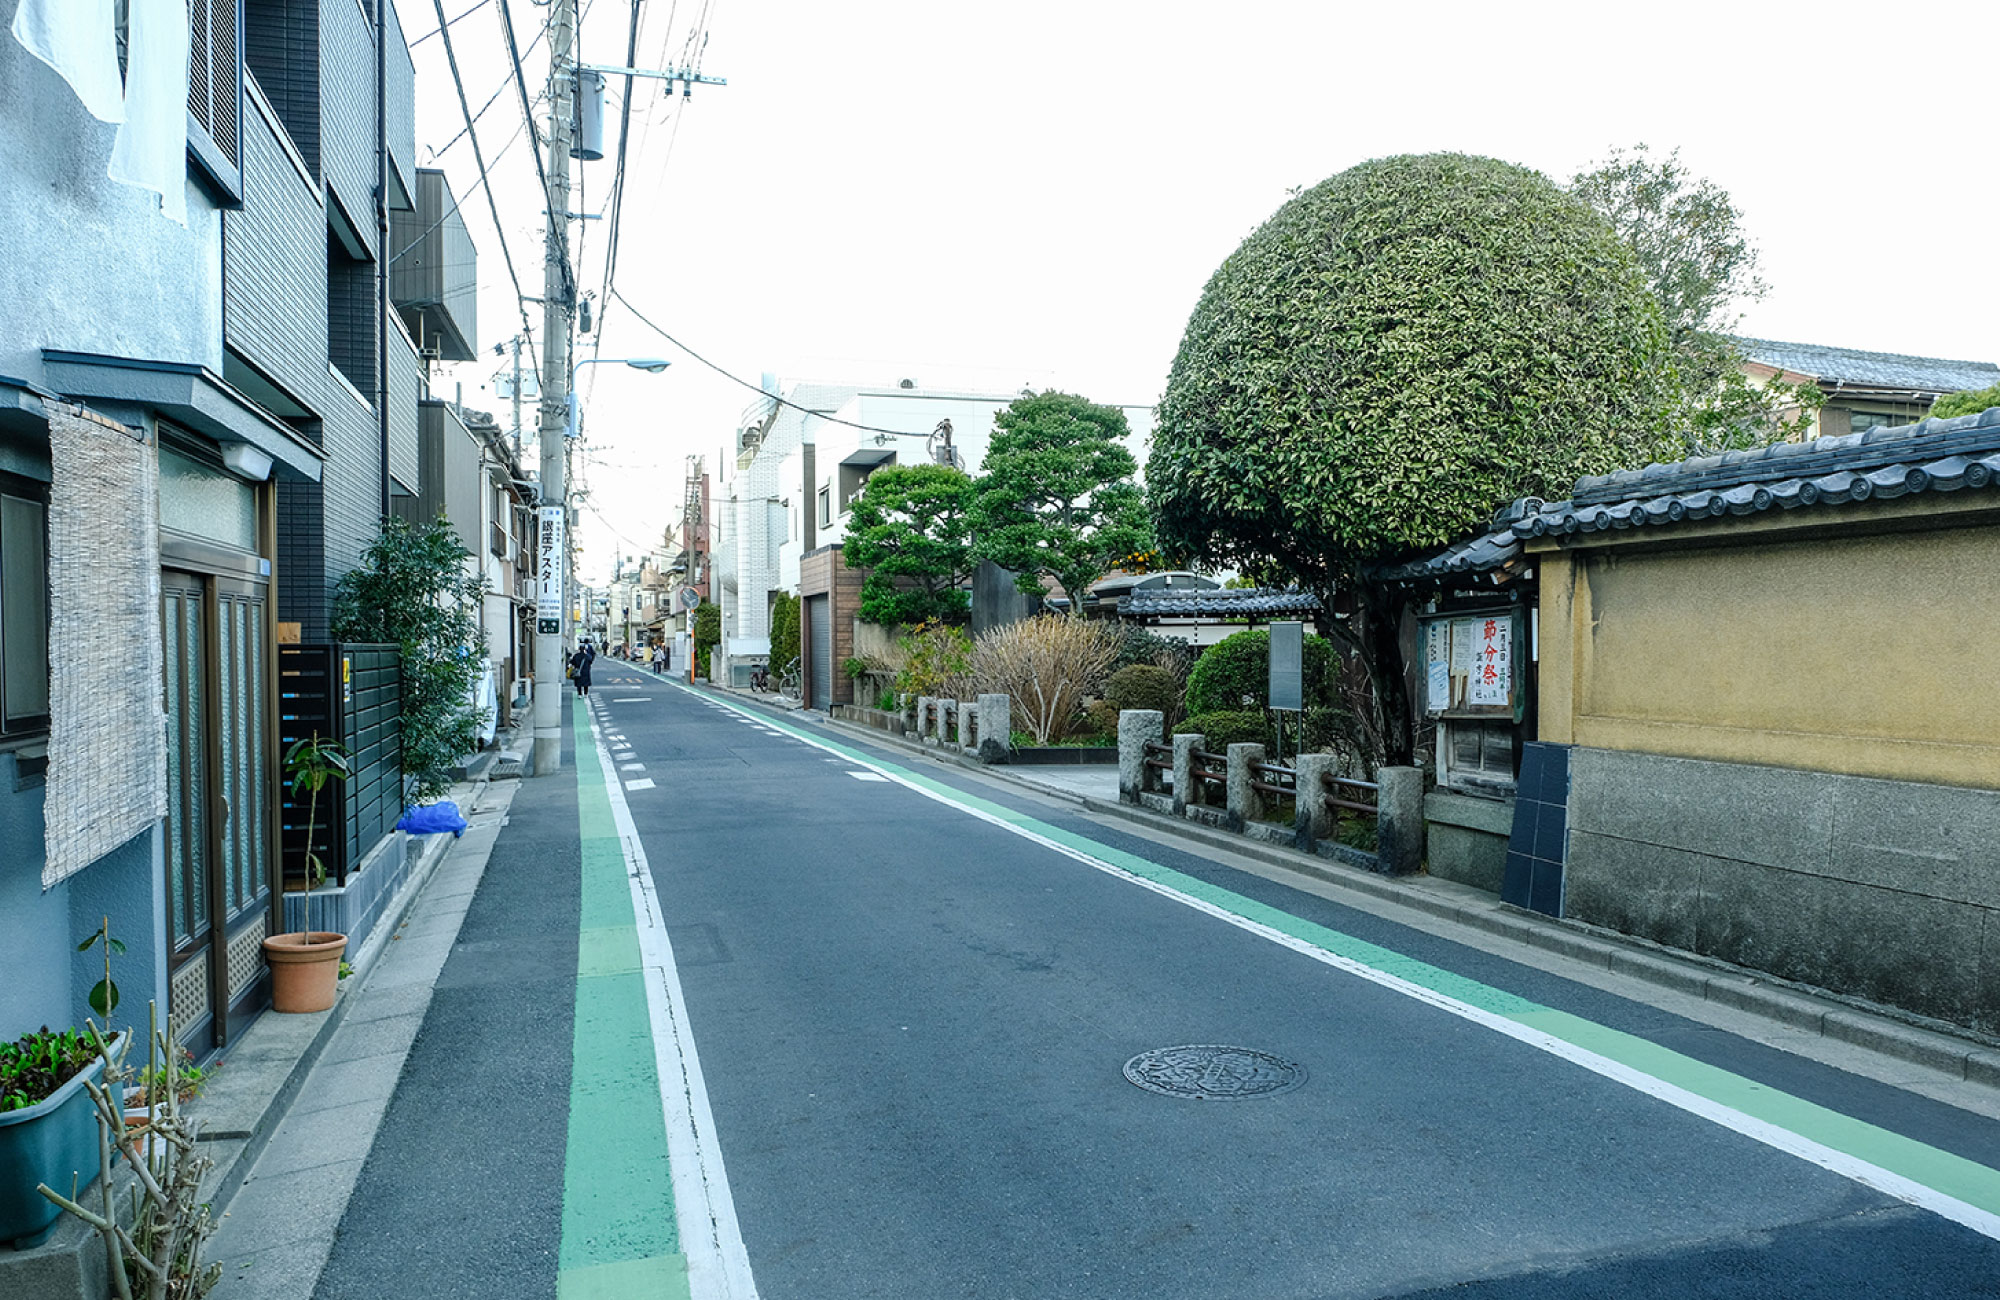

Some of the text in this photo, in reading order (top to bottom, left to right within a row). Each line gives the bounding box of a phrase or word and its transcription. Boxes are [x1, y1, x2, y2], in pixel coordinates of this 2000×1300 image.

[542, 520, 553, 593] 銀座アスター
[1483, 619, 1498, 686] 節分祭
